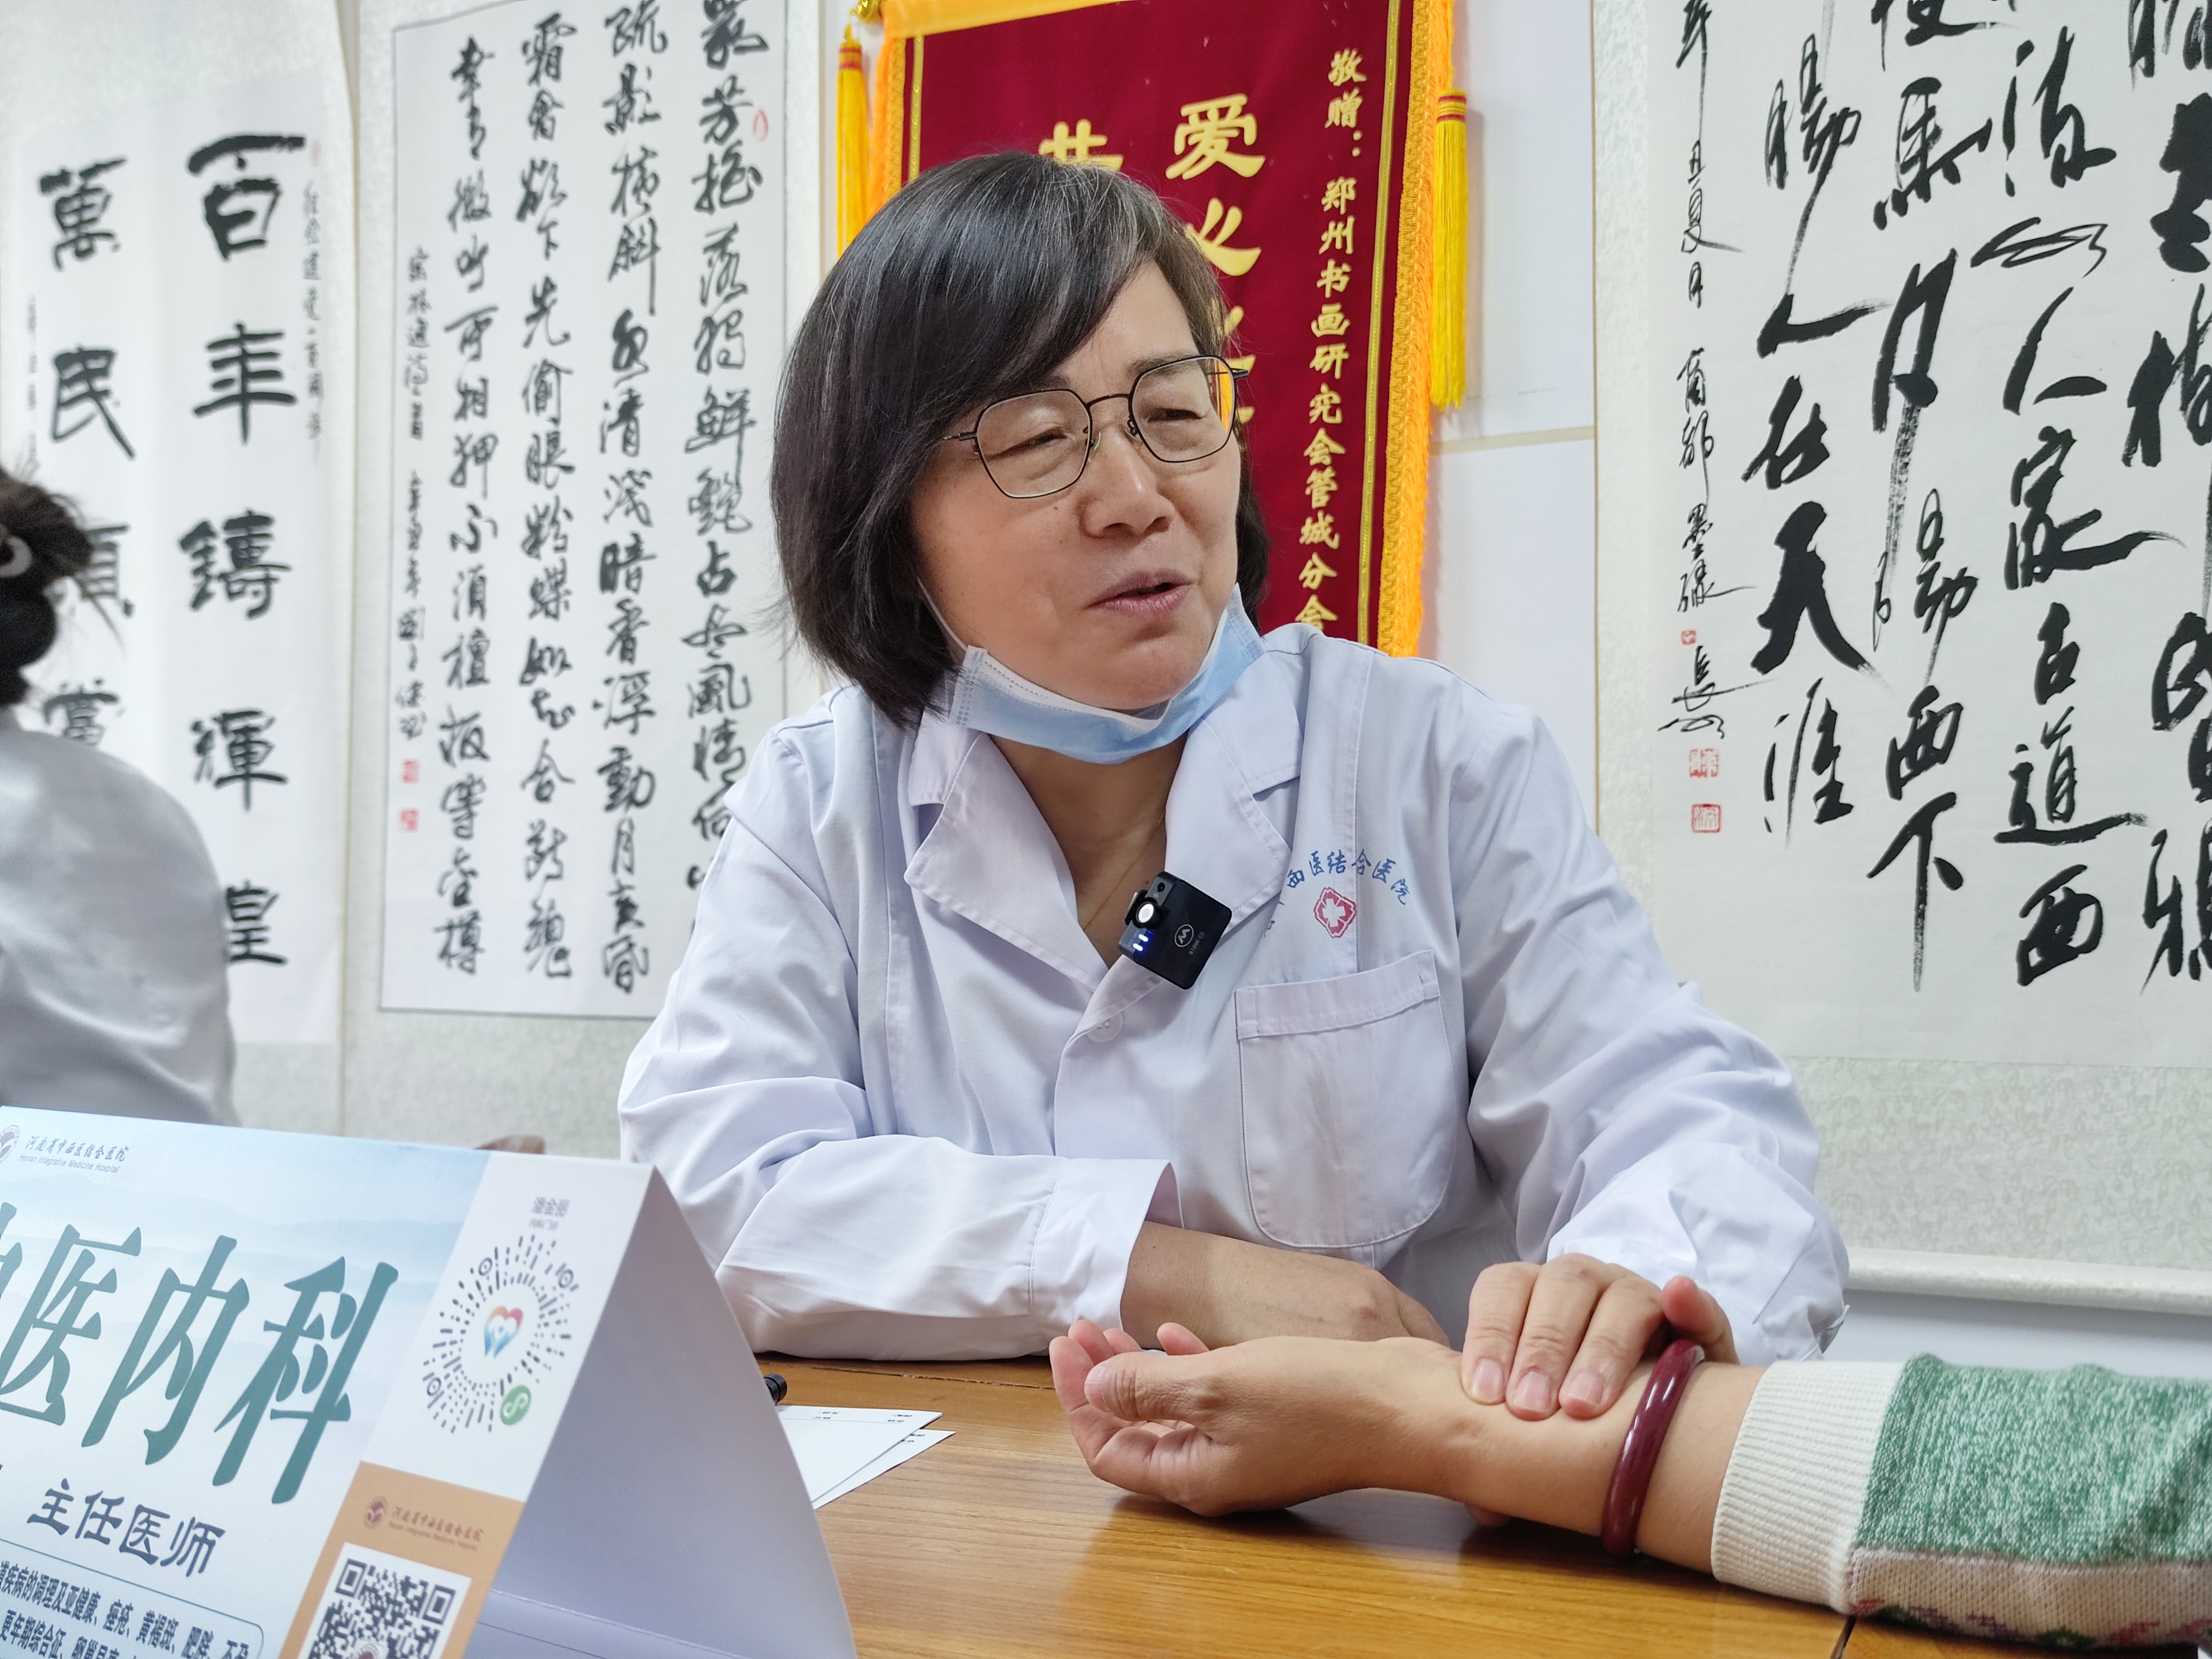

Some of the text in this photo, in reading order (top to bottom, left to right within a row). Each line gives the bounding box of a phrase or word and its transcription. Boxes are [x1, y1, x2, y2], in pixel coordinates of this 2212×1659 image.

[26, 1136, 129, 1162] 河南省中西医结合医院
[68, 1159, 94, 1170] Medicine
[95, 1163, 120, 1173] Hospital
[27, 1478, 226, 1577] 主任医师
